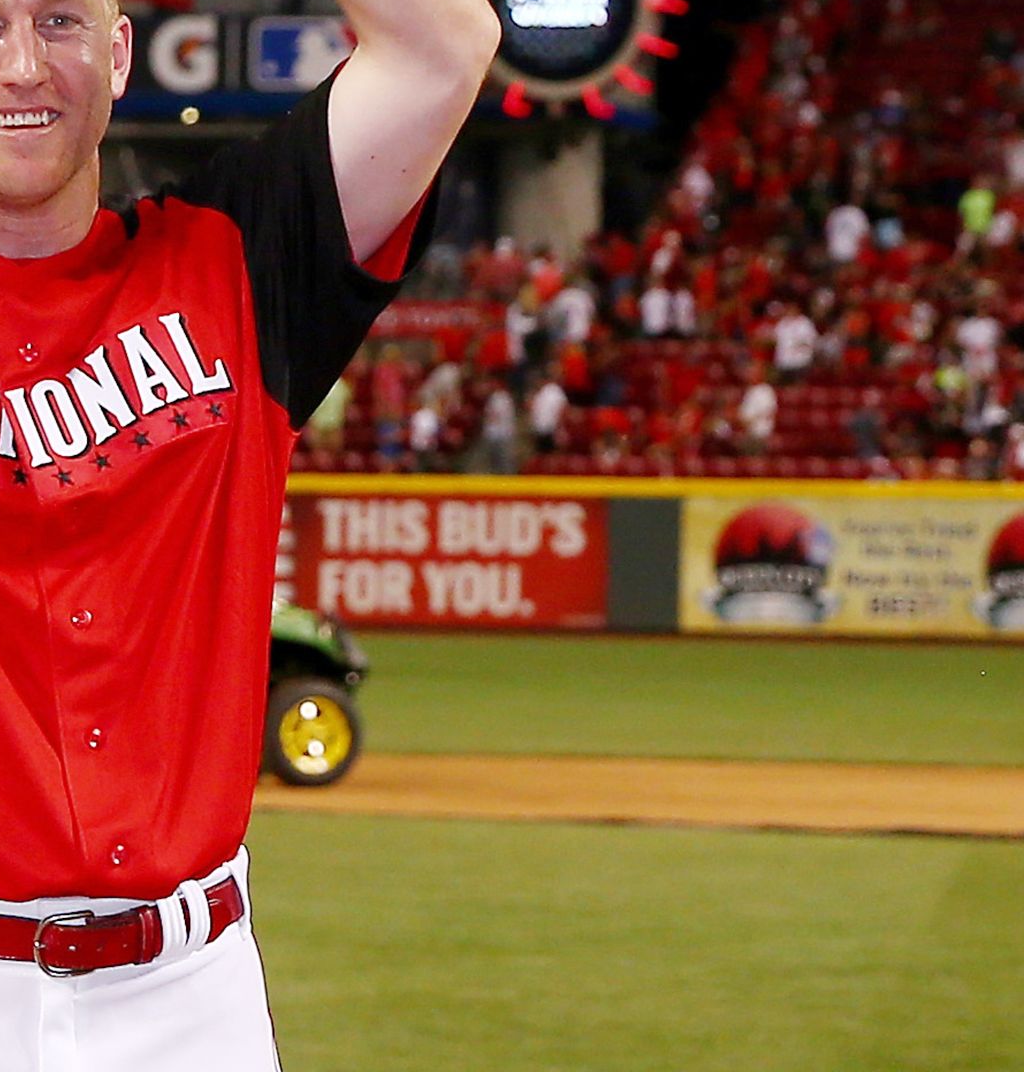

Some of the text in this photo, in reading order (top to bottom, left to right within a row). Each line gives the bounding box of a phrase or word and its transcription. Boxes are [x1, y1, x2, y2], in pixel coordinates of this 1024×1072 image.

[317, 498, 430, 556] THIS
[437, 499, 588, 558] BUD'S
[317, 559, 536, 618] FOR YOU.
